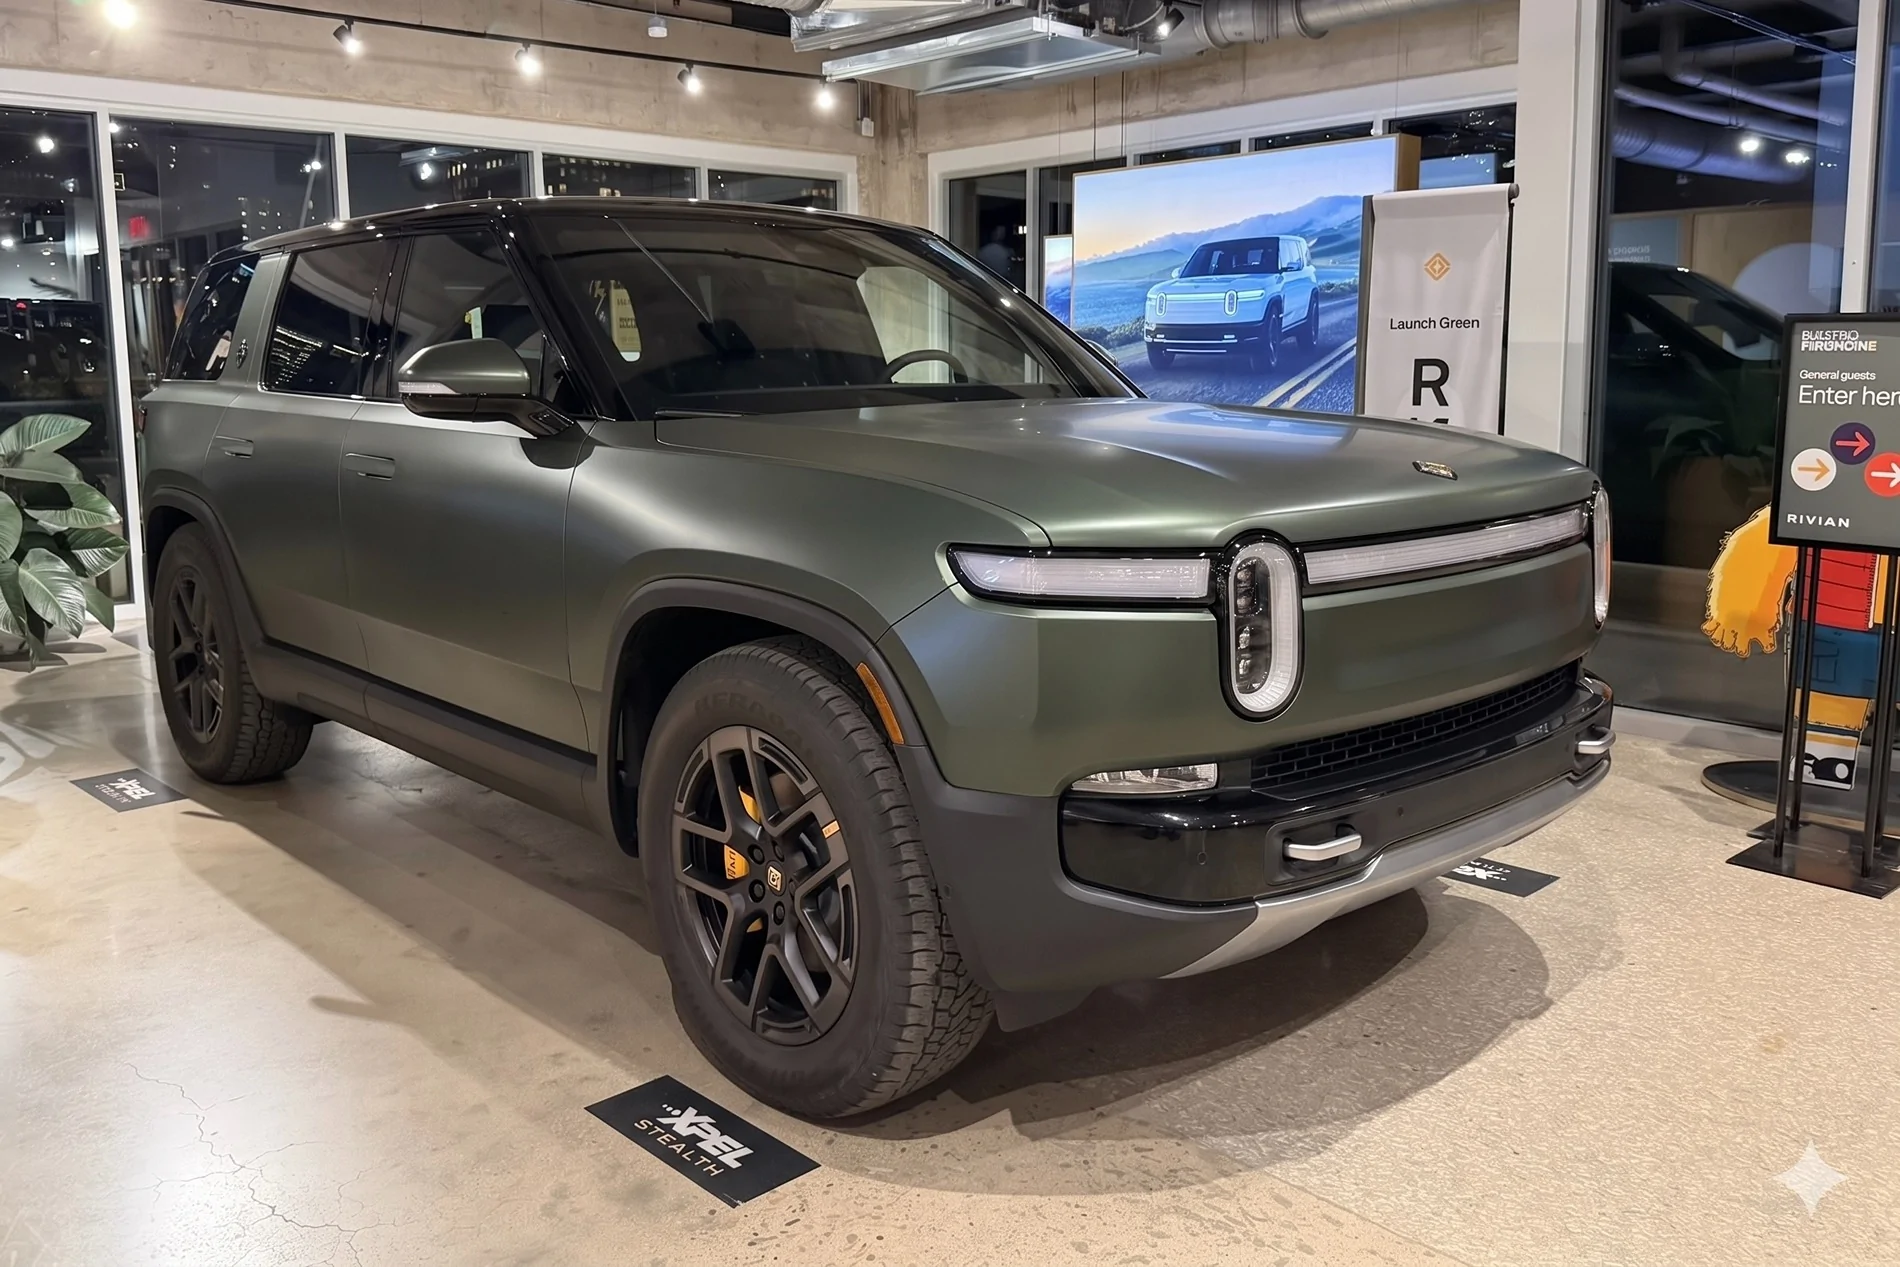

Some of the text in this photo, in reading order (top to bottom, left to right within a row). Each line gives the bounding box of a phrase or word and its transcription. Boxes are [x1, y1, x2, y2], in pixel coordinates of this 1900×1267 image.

[1390, 317, 1480, 330] Launch Green
[1412, 358, 1450, 406] R
[1799, 369, 1876, 382] General guests
[1798, 384, 1858, 405] Enter
[1787, 513, 1850, 528] RIVIAN
[656, 1105, 754, 1169] XPEL
[634, 1119, 725, 1177] STEALTH
